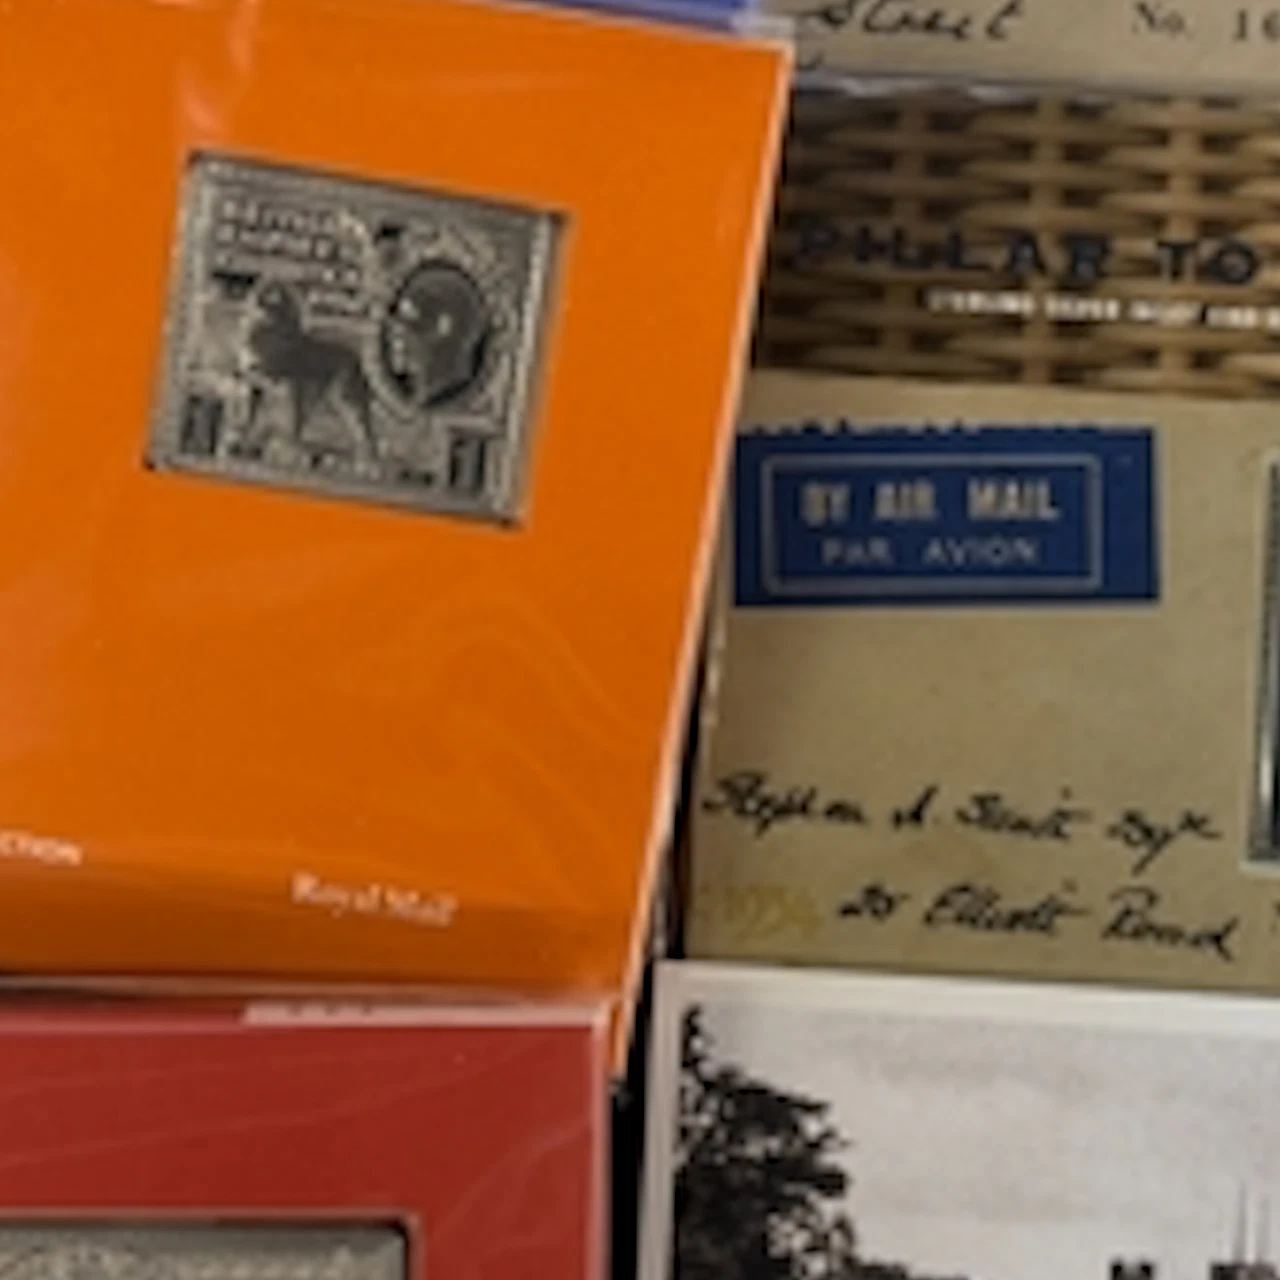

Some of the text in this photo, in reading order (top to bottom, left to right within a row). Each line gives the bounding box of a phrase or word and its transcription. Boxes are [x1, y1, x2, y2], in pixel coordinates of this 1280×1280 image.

[792, 218, 1112, 286] PILLAR
[1156, 239, 1260, 286] TO
[800, 476, 1061, 527] BY AIR MAIL
[822, 534, 1040, 567] PAR AVION
